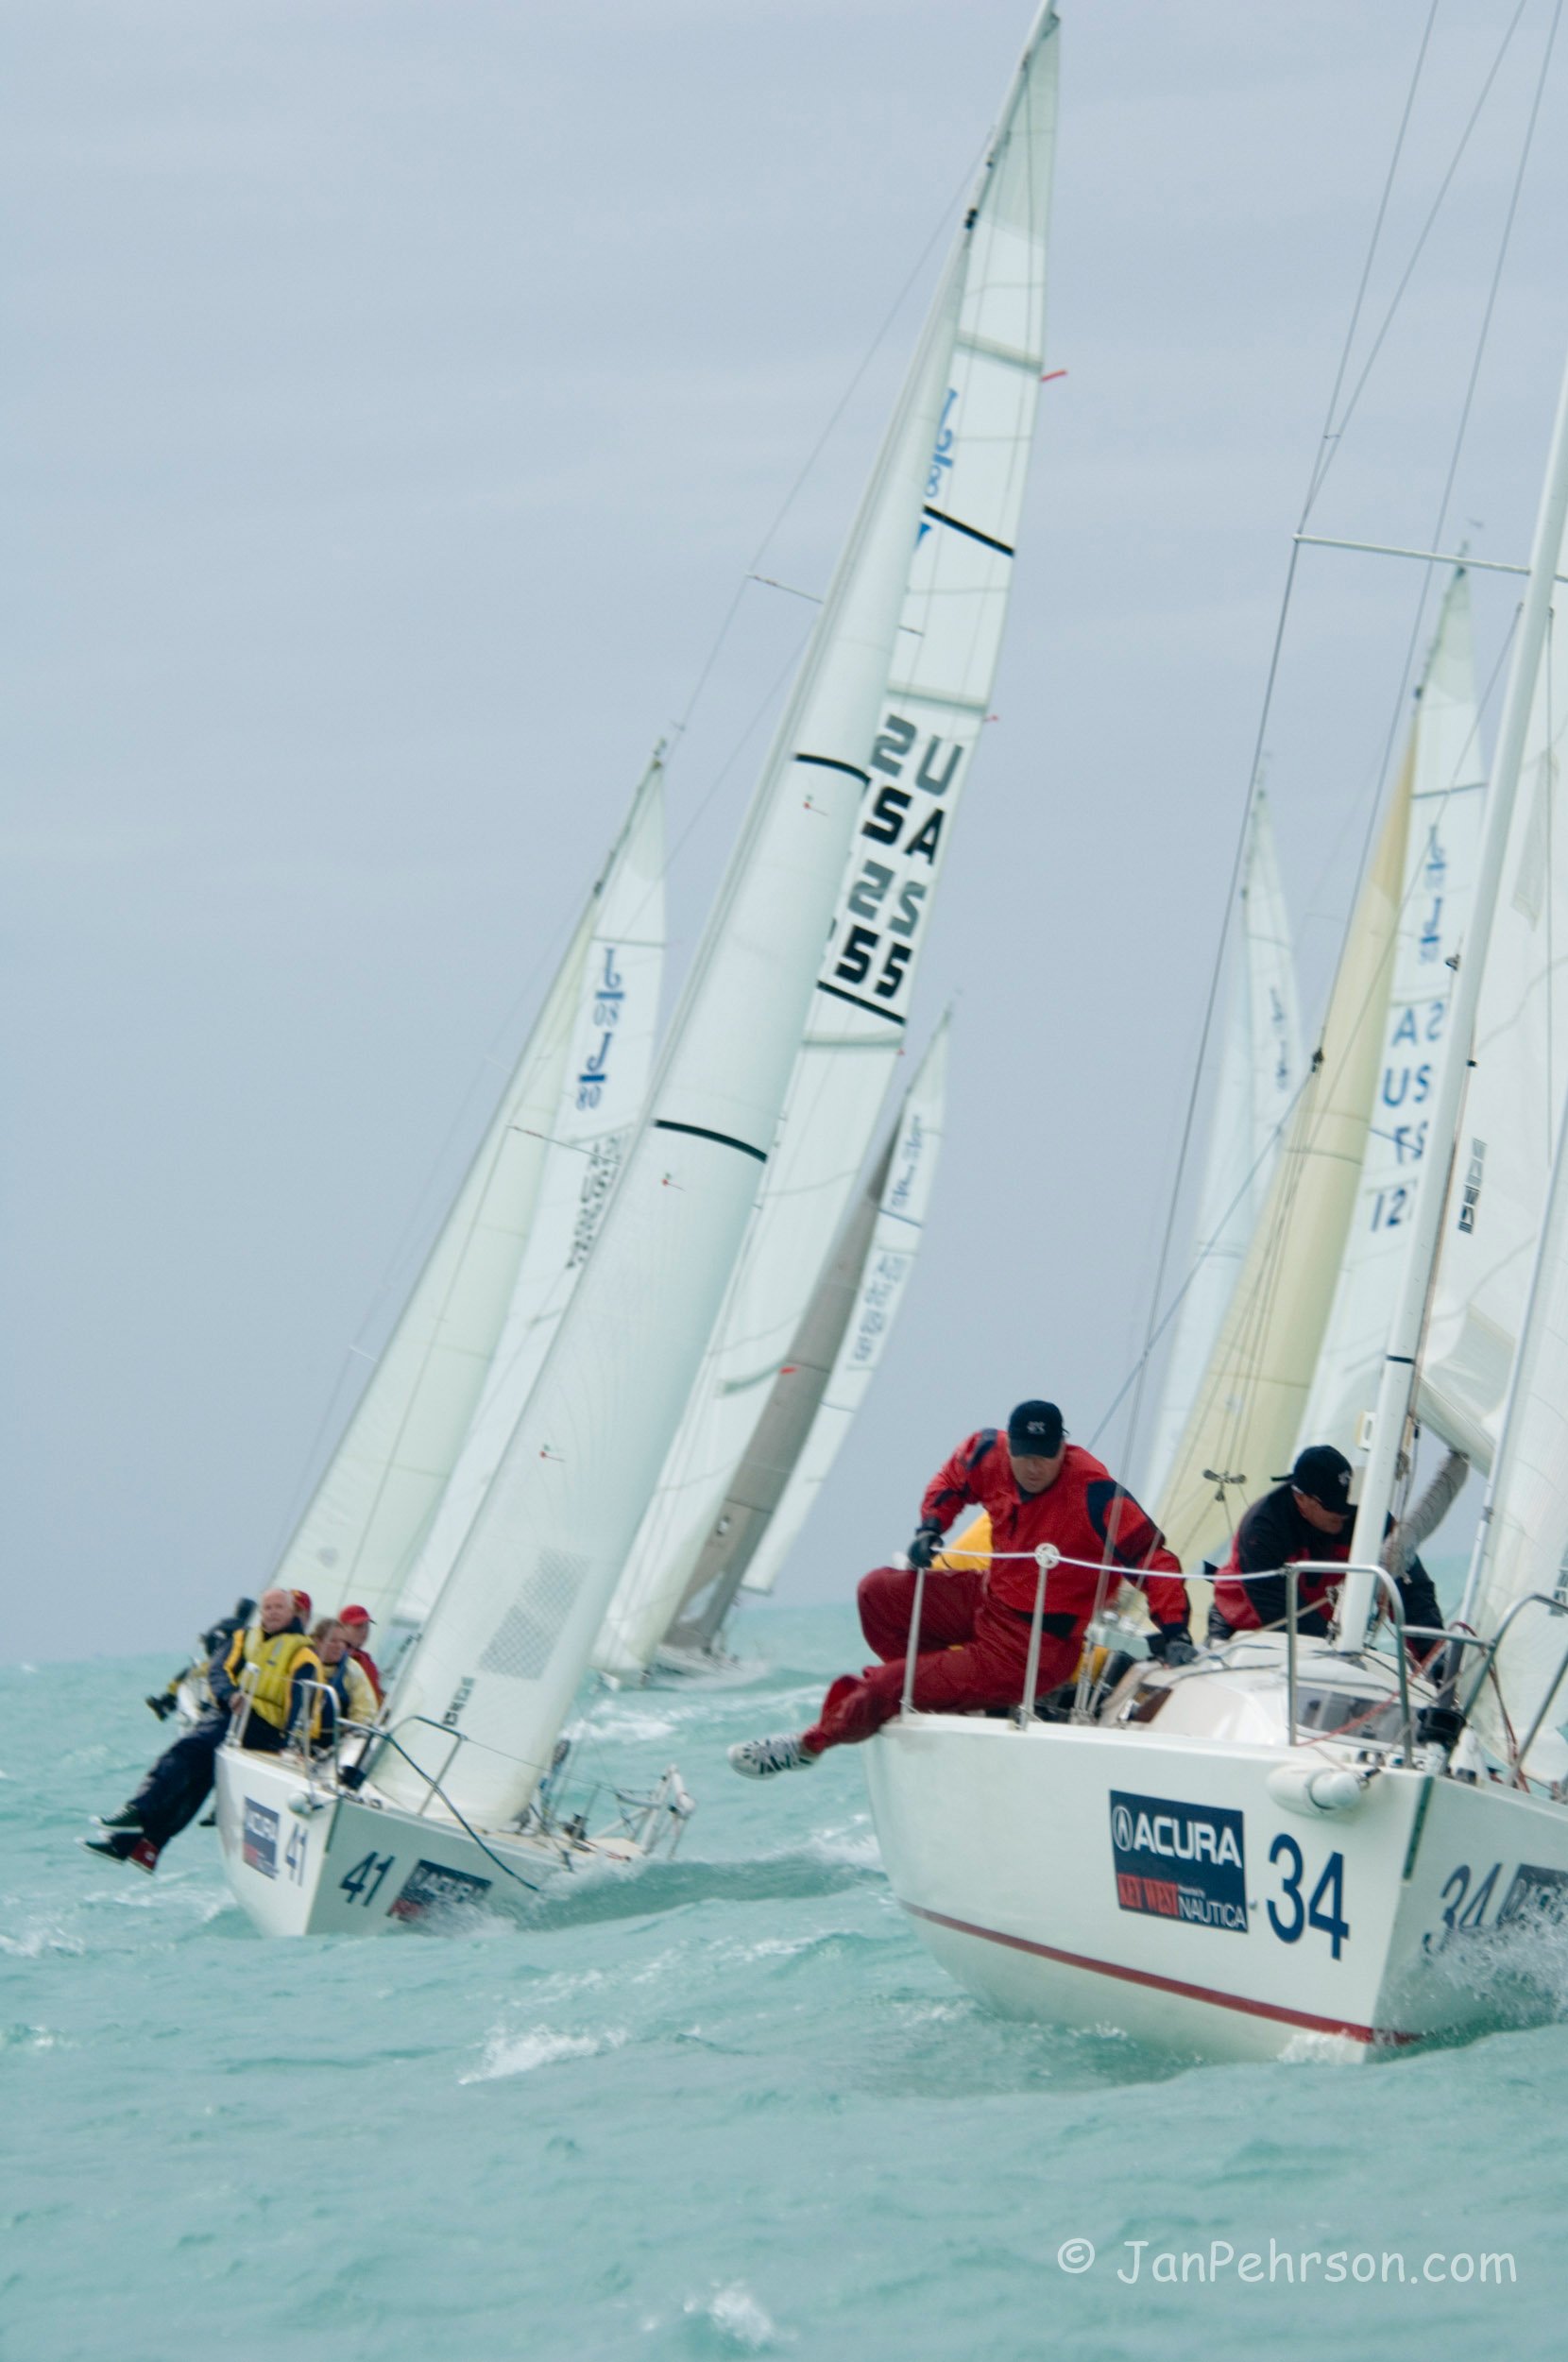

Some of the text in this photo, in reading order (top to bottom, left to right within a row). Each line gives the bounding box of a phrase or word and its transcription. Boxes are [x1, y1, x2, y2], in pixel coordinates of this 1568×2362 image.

[861, 786, 946, 866] SA
[827, 917, 912, 1000] 55
[1371, 1188, 1413, 1232] 12
[284, 1822, 310, 1888] 41
[1133, 1812, 1243, 1869] ACURA
[339, 1851, 395, 1907] 41
[1178, 1895, 1247, 1929] NAUTICA
[1266, 1833, 1350, 1961] 34
[1424, 1863, 1503, 1956] 34
